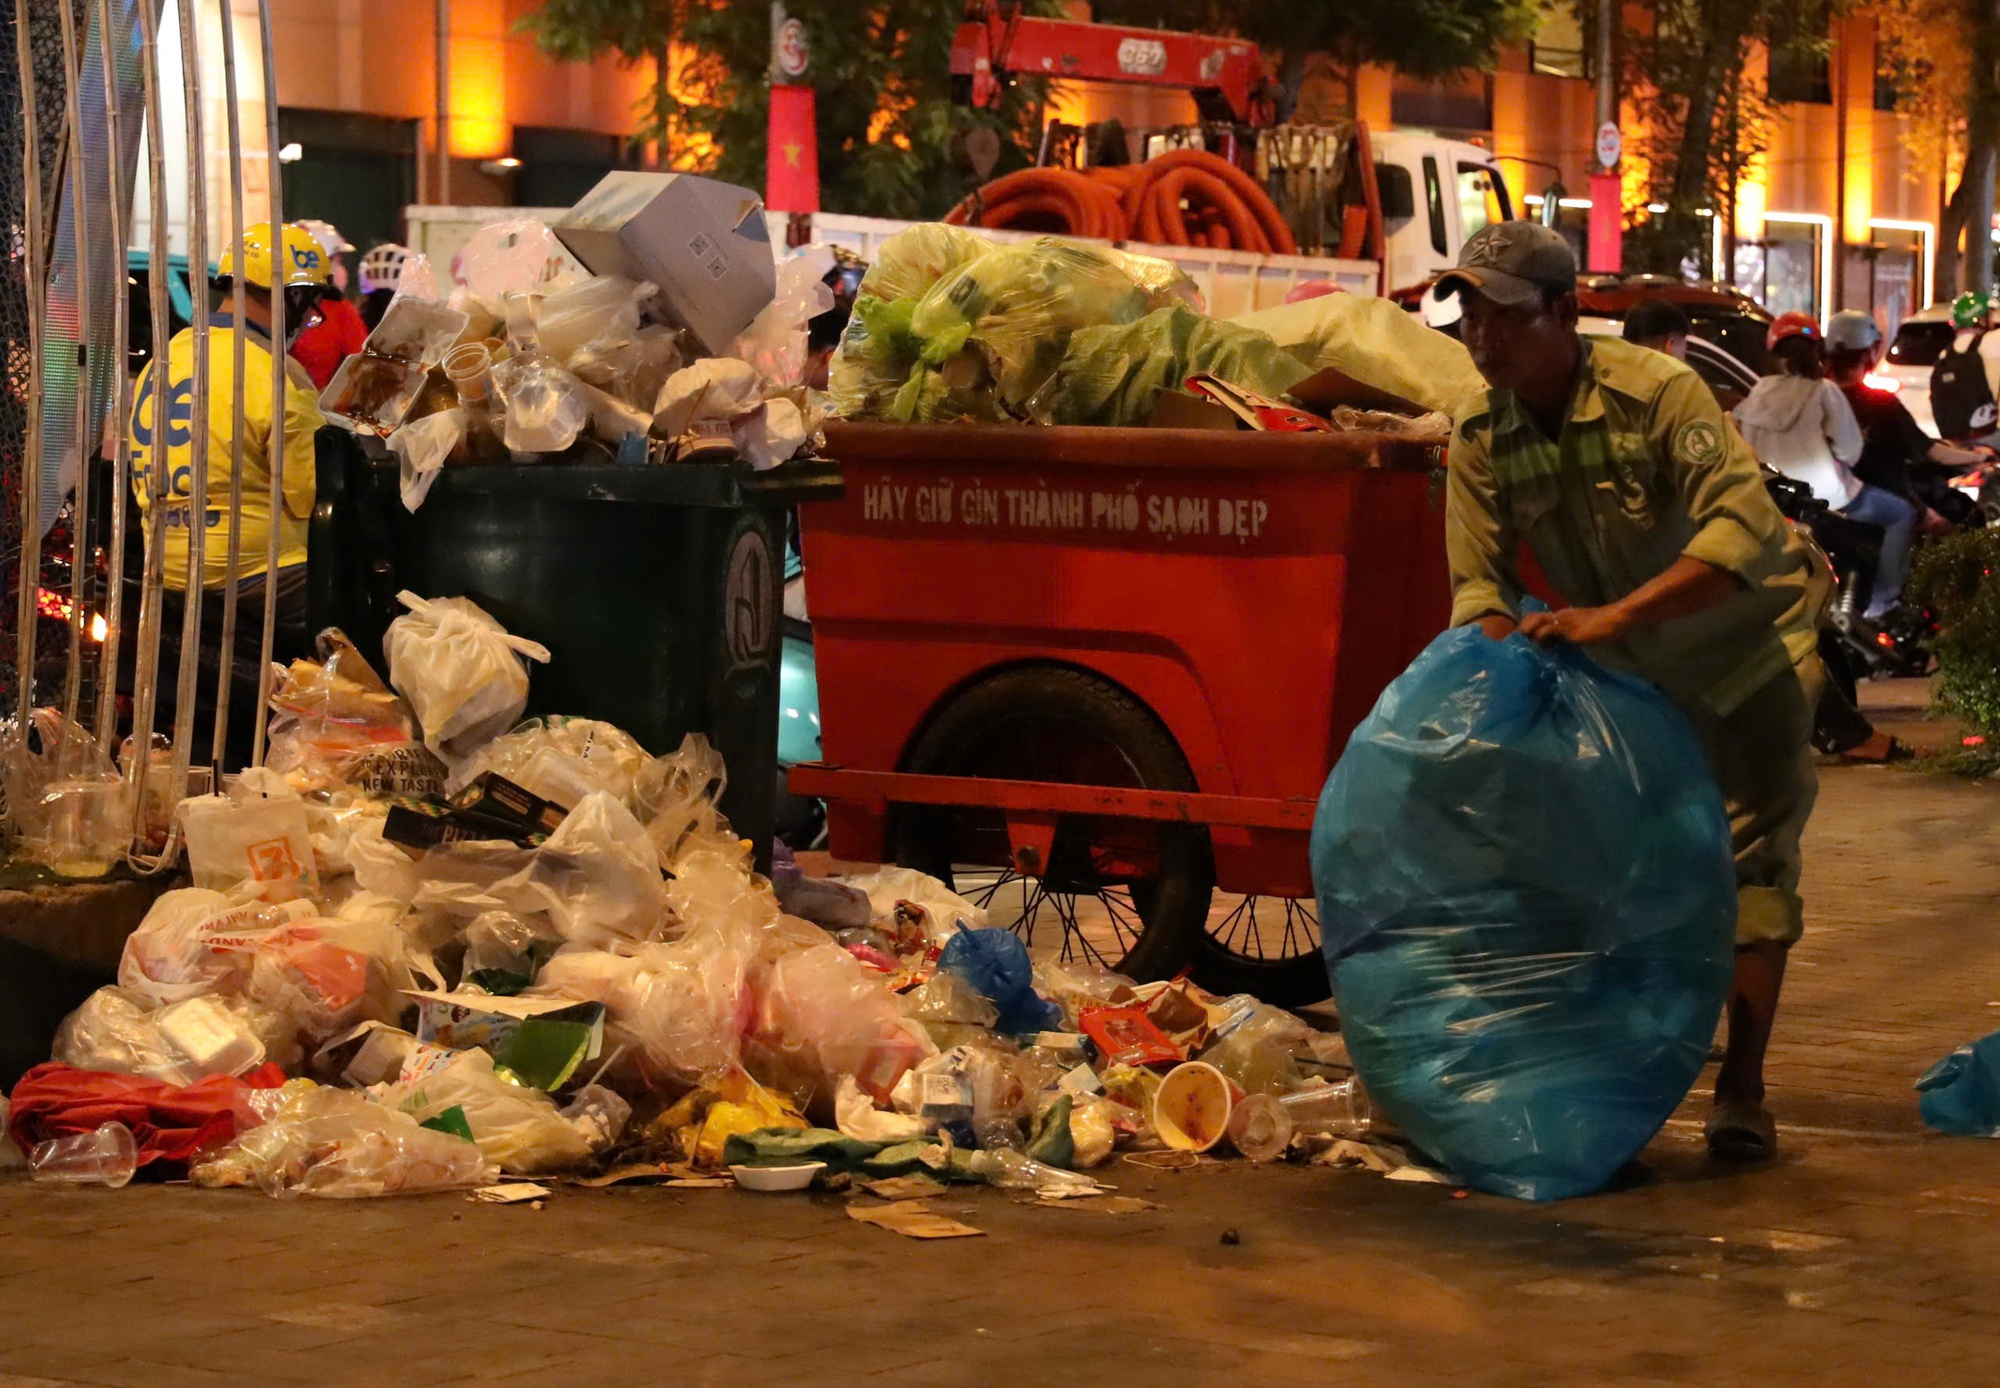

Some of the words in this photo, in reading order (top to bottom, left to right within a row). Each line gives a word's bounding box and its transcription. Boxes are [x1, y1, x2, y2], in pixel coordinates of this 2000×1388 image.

[290, 244, 319, 269] be
[864, 475, 909, 521] HÃY
[960, 478, 999, 525] GÌN
[1004, 478, 1084, 528] THÀNH
[1091, 479, 1142, 531] PHỐ
[1217, 499, 1268, 545] ĐẸP
[362, 778, 395, 792] NEW
